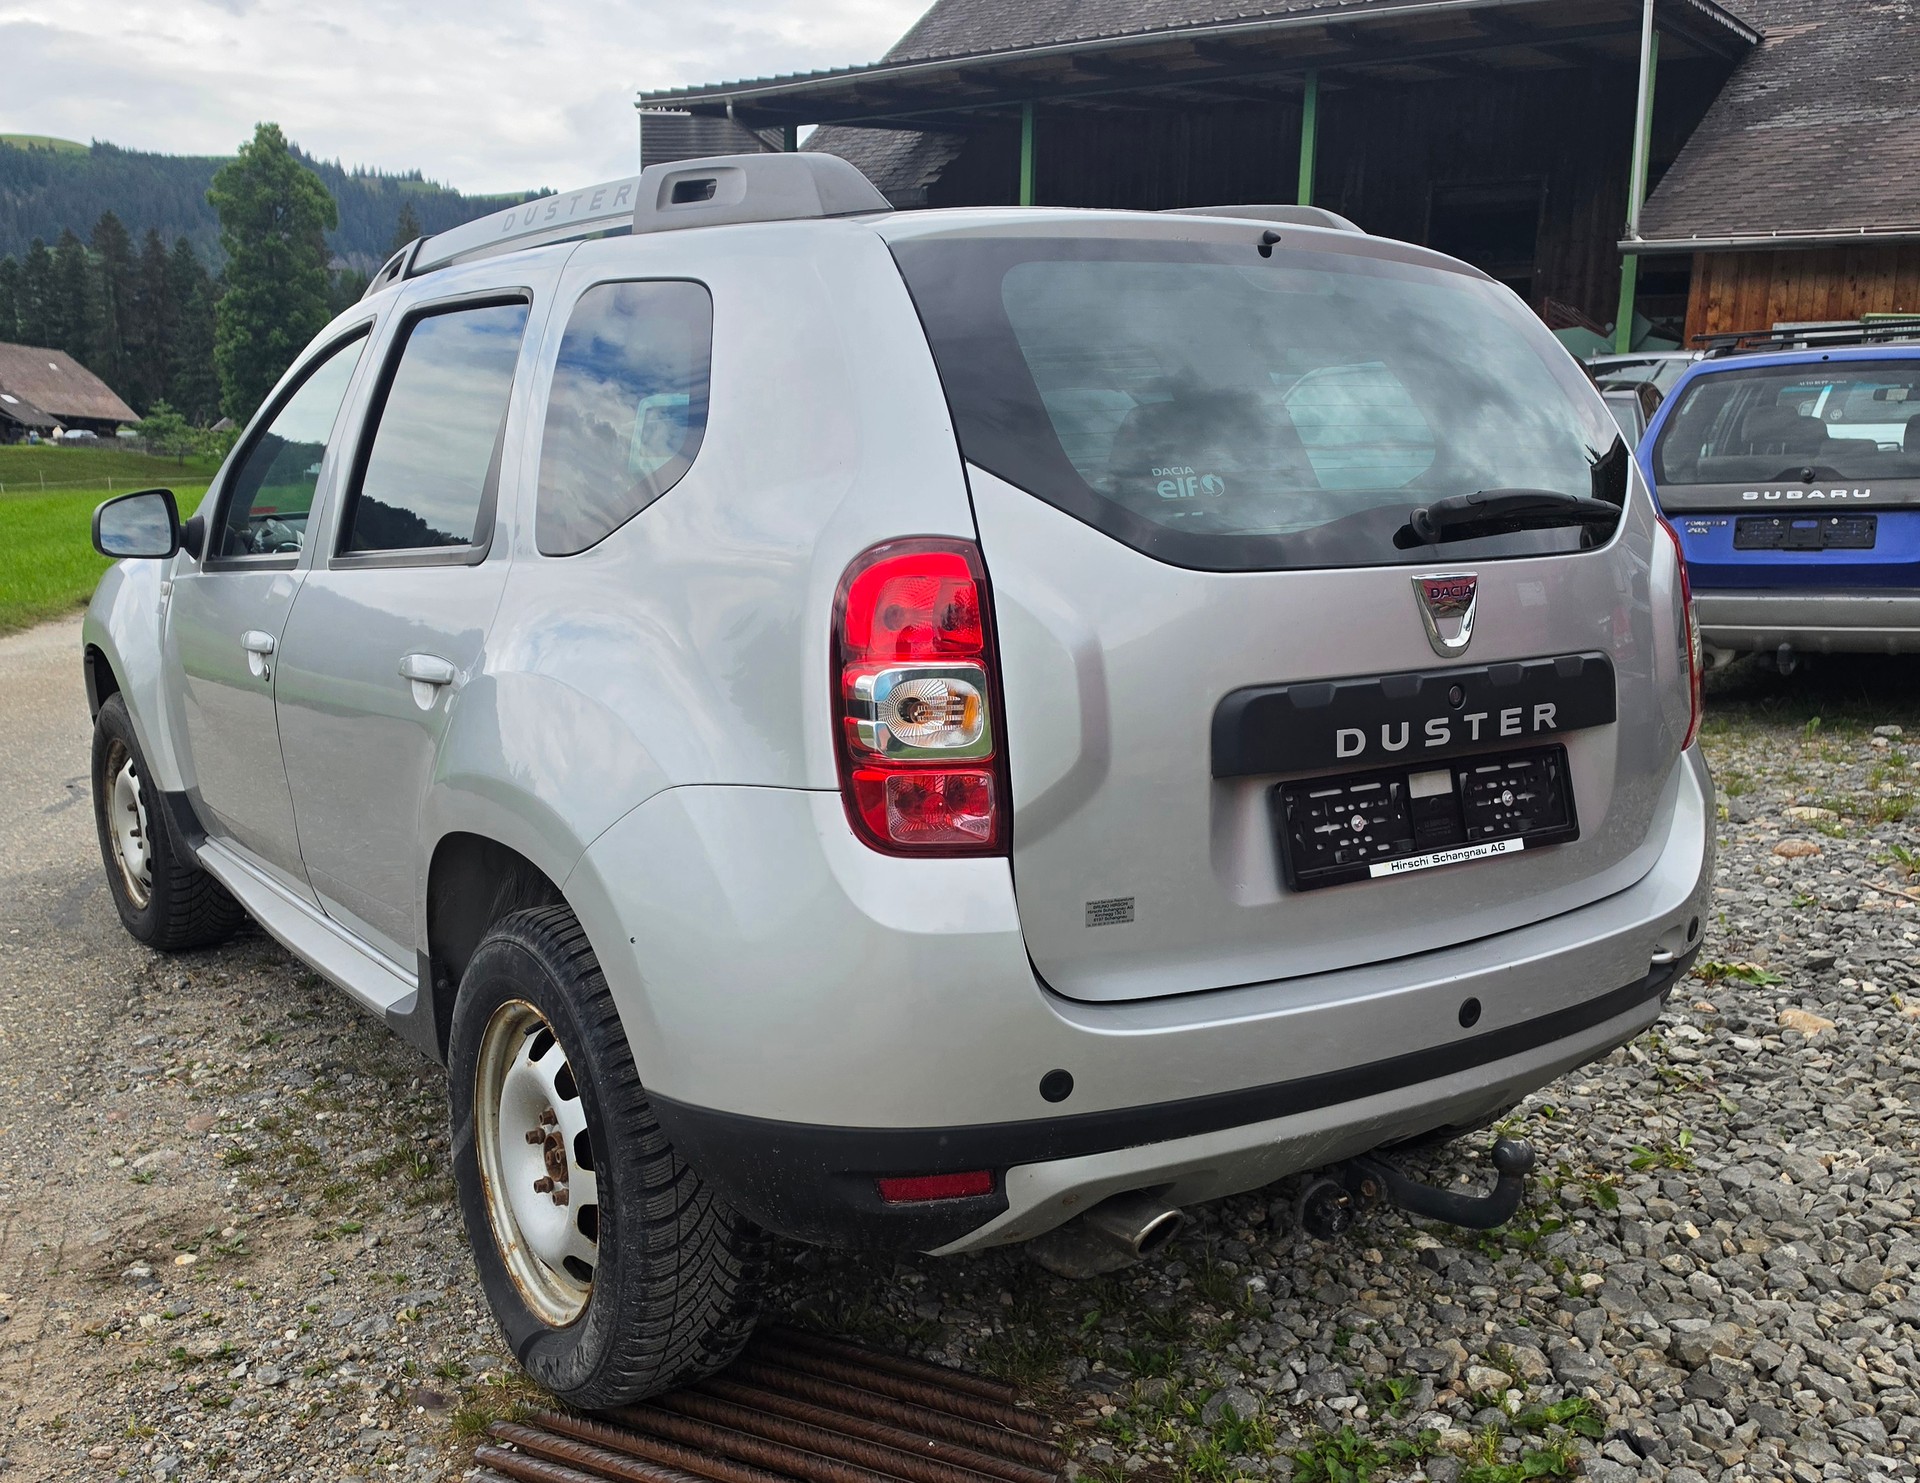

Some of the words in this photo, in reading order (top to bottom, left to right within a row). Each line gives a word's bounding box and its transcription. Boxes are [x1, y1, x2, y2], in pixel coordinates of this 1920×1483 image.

[501, 183, 632, 233] DUSTER
[1151, 466, 1195, 476] DACIA
[1157, 476, 1198, 498] elf
[1742, 488, 1871, 500] SUBARU
[1430, 585, 1472, 598] DACIA
[1336, 702, 1558, 758] DUSTER
[1391, 856, 1430, 871] Hirschi
[1432, 847, 1487, 863] Schangnau
[1490, 842, 1506, 853] AG
